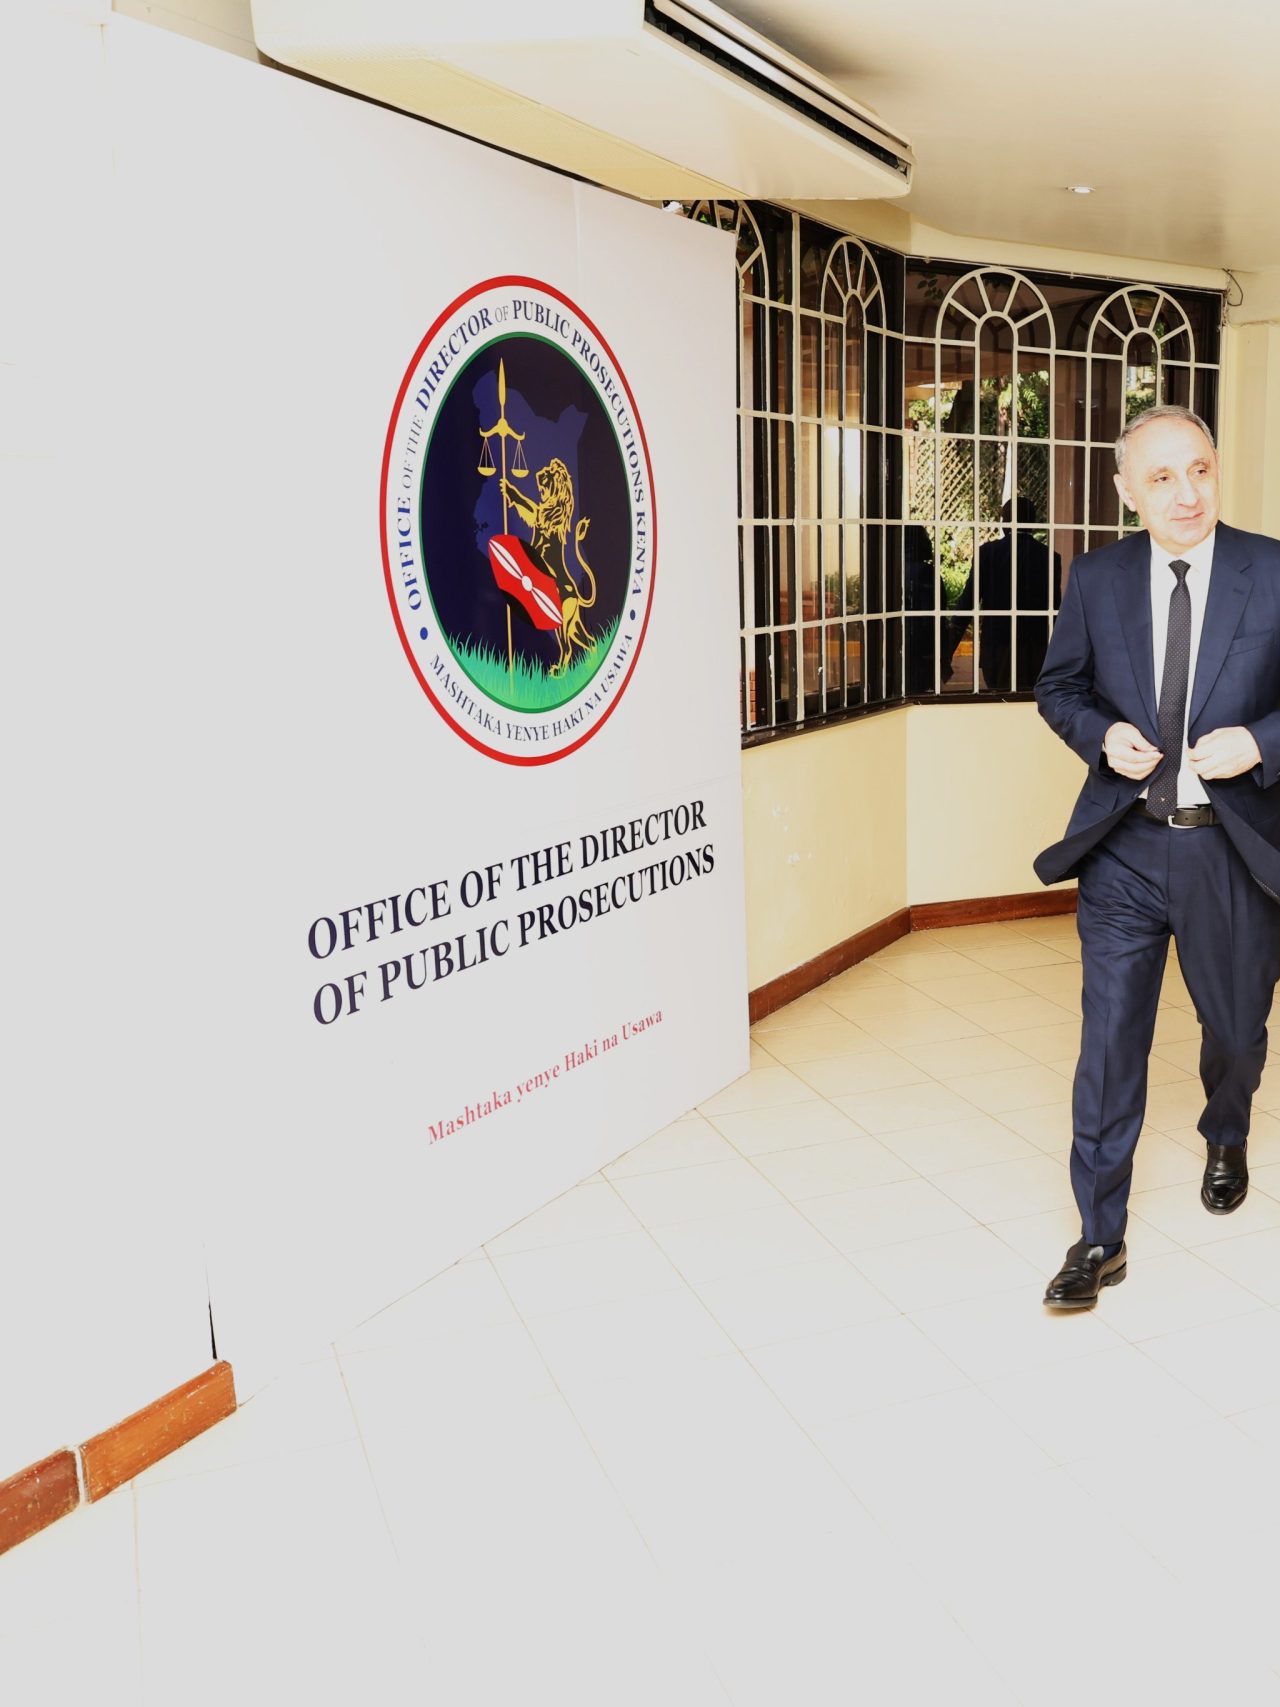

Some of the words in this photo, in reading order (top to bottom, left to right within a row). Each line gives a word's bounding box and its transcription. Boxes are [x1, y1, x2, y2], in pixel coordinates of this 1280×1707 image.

[414, 306, 494, 412] DIRECTOR
[494, 305, 510, 324] OF
[511, 299, 571, 340] PUBLIC
[406, 414, 425, 457] THE
[570, 328, 645, 504] PROSECUTIONS
[402, 459, 415, 489] OF
[397, 496, 422, 611] OFFICE
[630, 511, 646, 596] KENYA
[429, 653, 503, 737] MASHTAKA
[505, 722, 551, 742] YENYE
[551, 710, 586, 738] HAKI
[584, 691, 603, 715] NA
[600, 633, 633, 694] USAWA
[307, 880, 452, 959] OFFICE
[459, 863, 504, 908] OF
[510, 841, 574, 891] THE
[579, 800, 707, 869] DIRECTOR
[313, 971, 368, 1025] OF
[377, 920, 511, 1002] PUBLIC
[517, 844, 715, 948] PROSECUTIONS
[427, 1089, 513, 1145] Mashtaka
[515, 1063, 561, 1102] yenye
[564, 1039, 599, 1073] Haki
[601, 1033, 619, 1053] na
[621, 1010, 663, 1041] Usawa
